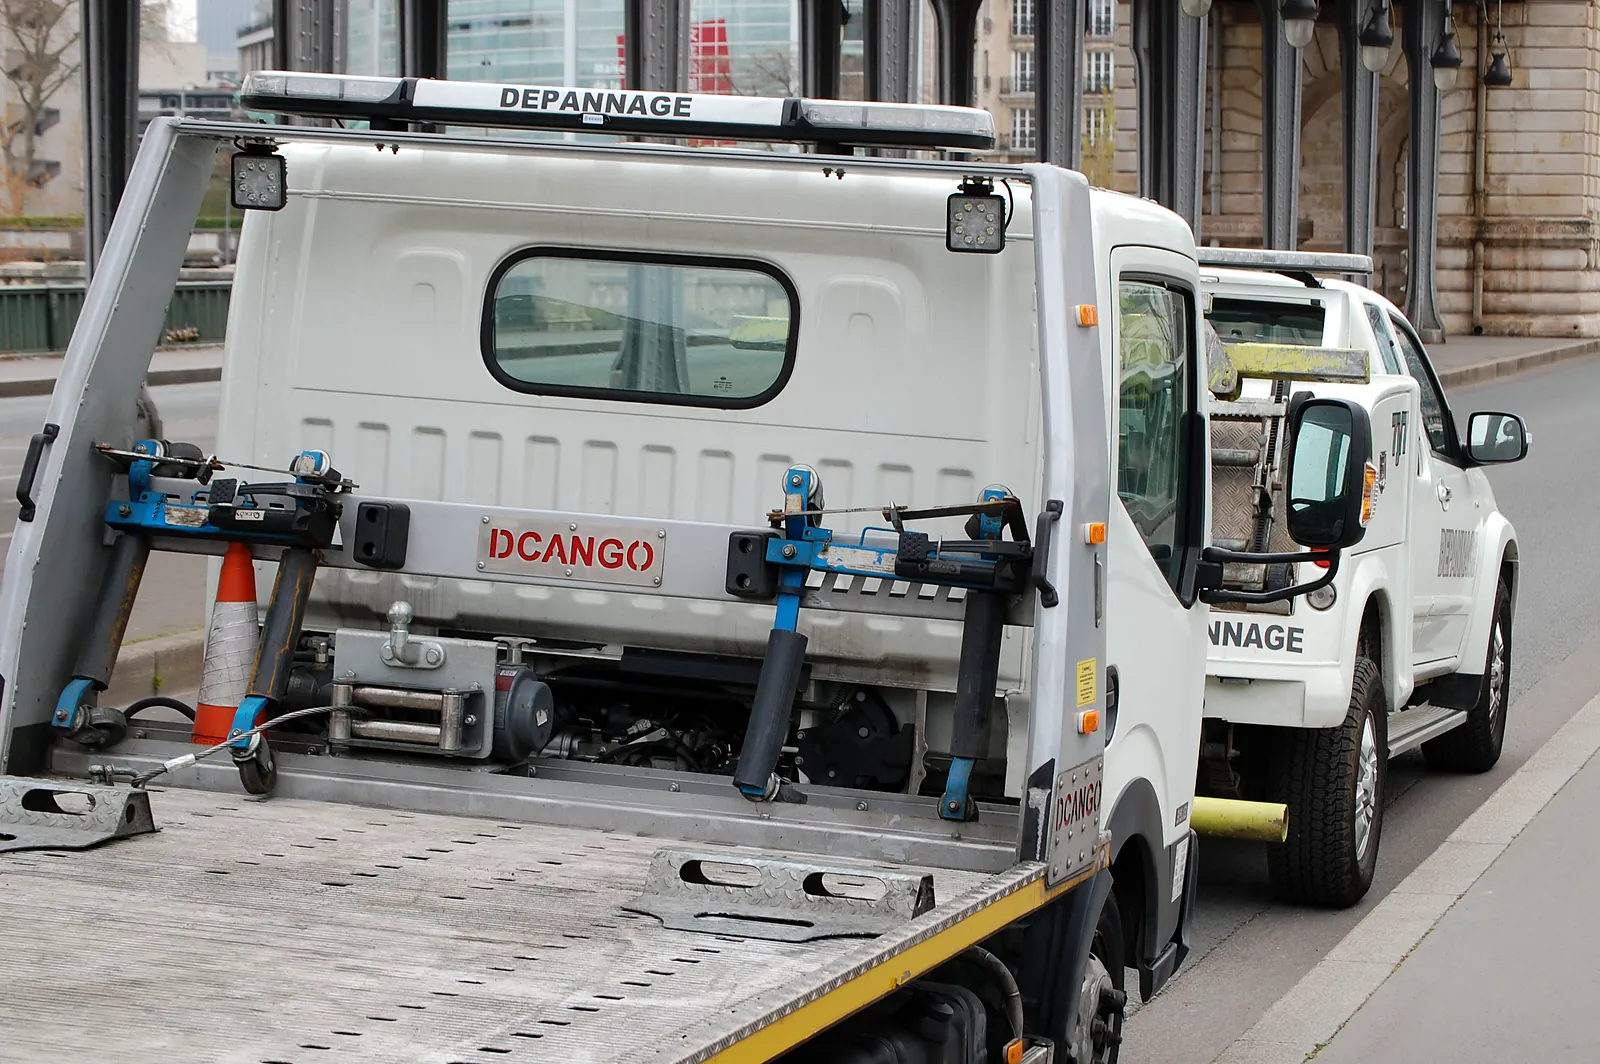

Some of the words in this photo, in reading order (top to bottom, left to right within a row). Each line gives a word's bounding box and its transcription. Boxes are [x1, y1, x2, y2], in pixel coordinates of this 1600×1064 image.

[499, 87, 693, 118] DEPANNAGE
[488, 527, 655, 572] DCANGO
[1055, 779, 1102, 832] DCANGO
